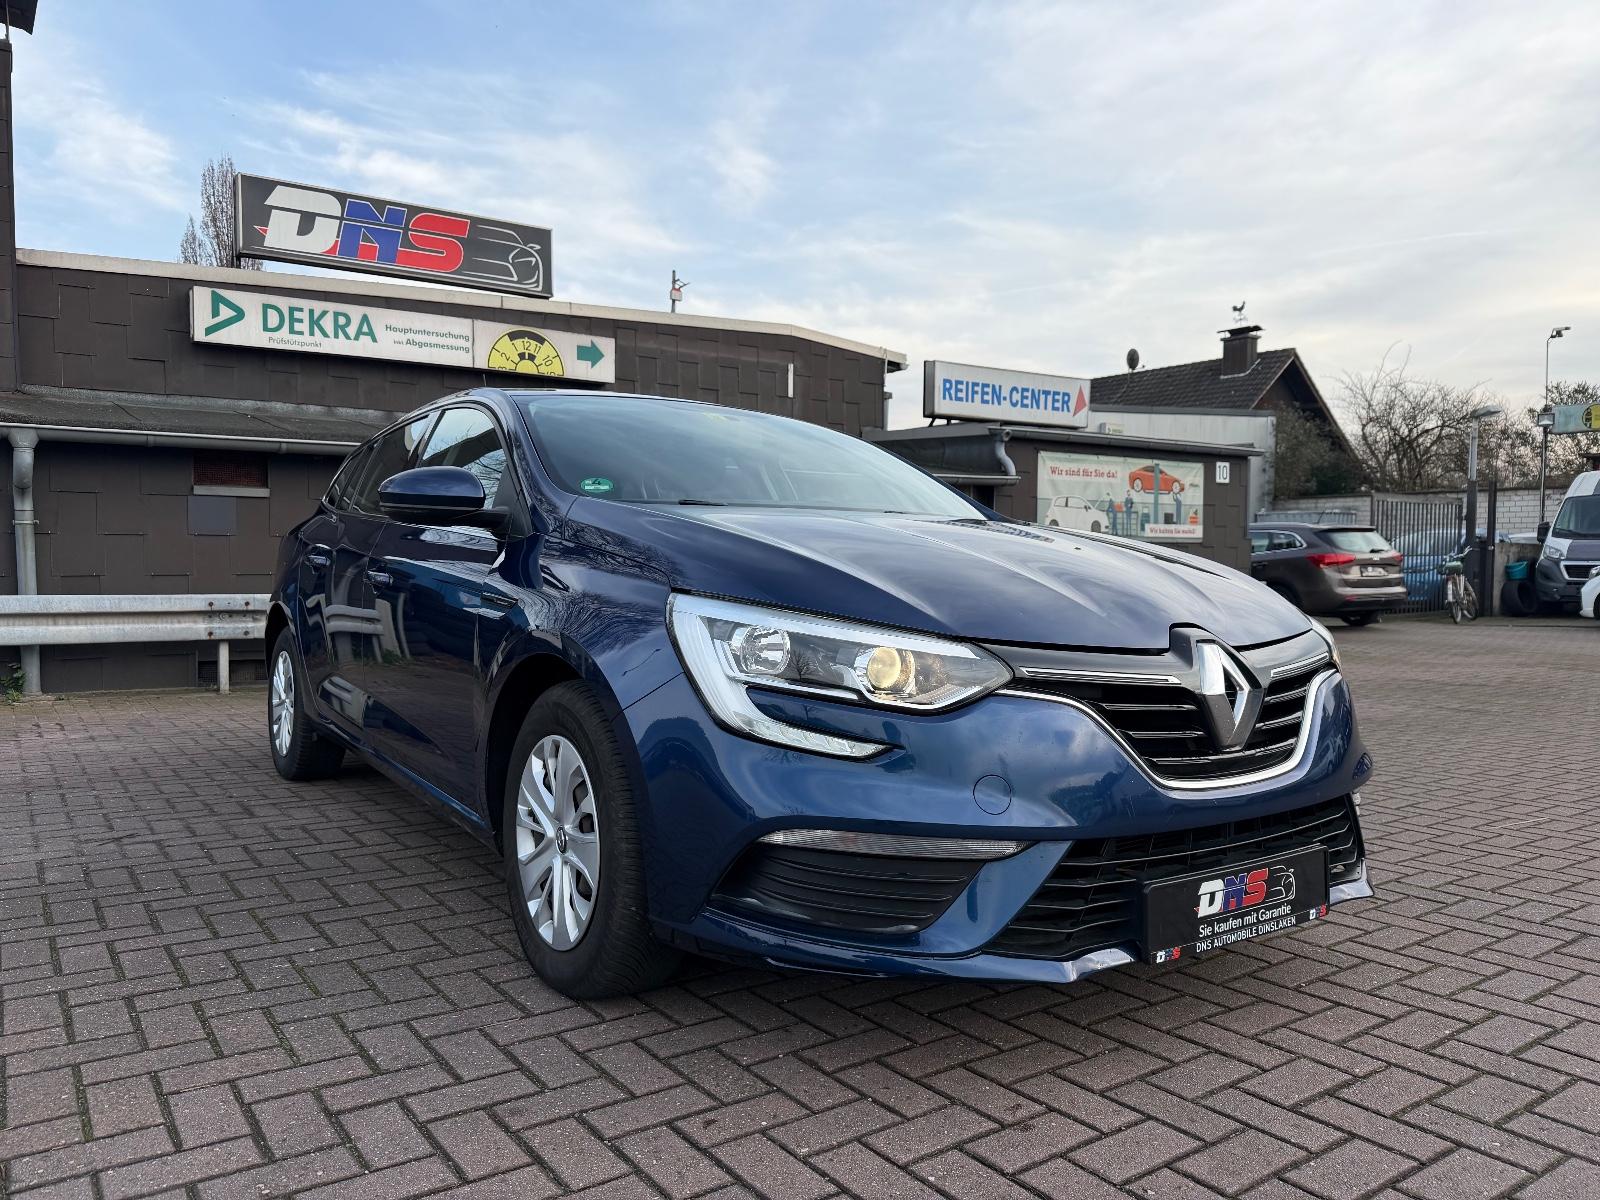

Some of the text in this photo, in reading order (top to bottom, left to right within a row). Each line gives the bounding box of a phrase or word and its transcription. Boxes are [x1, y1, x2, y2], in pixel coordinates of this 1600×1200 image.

[263, 184, 470, 273] DNS
[261, 303, 378, 343] DEKRA
[385, 324, 470, 342] Hauptuntersuchung
[268, 336, 322, 348] Prüfstützpunkt
[405, 338, 470, 353] Abgasmessung
[521, 340, 532, 352] 12
[942, 378, 1072, 413] REIFEN-CENTER
[1050, 465, 1118, 479] Wir sind für Sie da!
[1218, 465, 1228, 480] 10
[1198, 868, 1268, 918] DNS
[1199, 903, 1291, 938] Sie kaufen mit Garantie
[1196, 915, 1296, 953] DNS AUTOMOBILE DINSLAKEN
